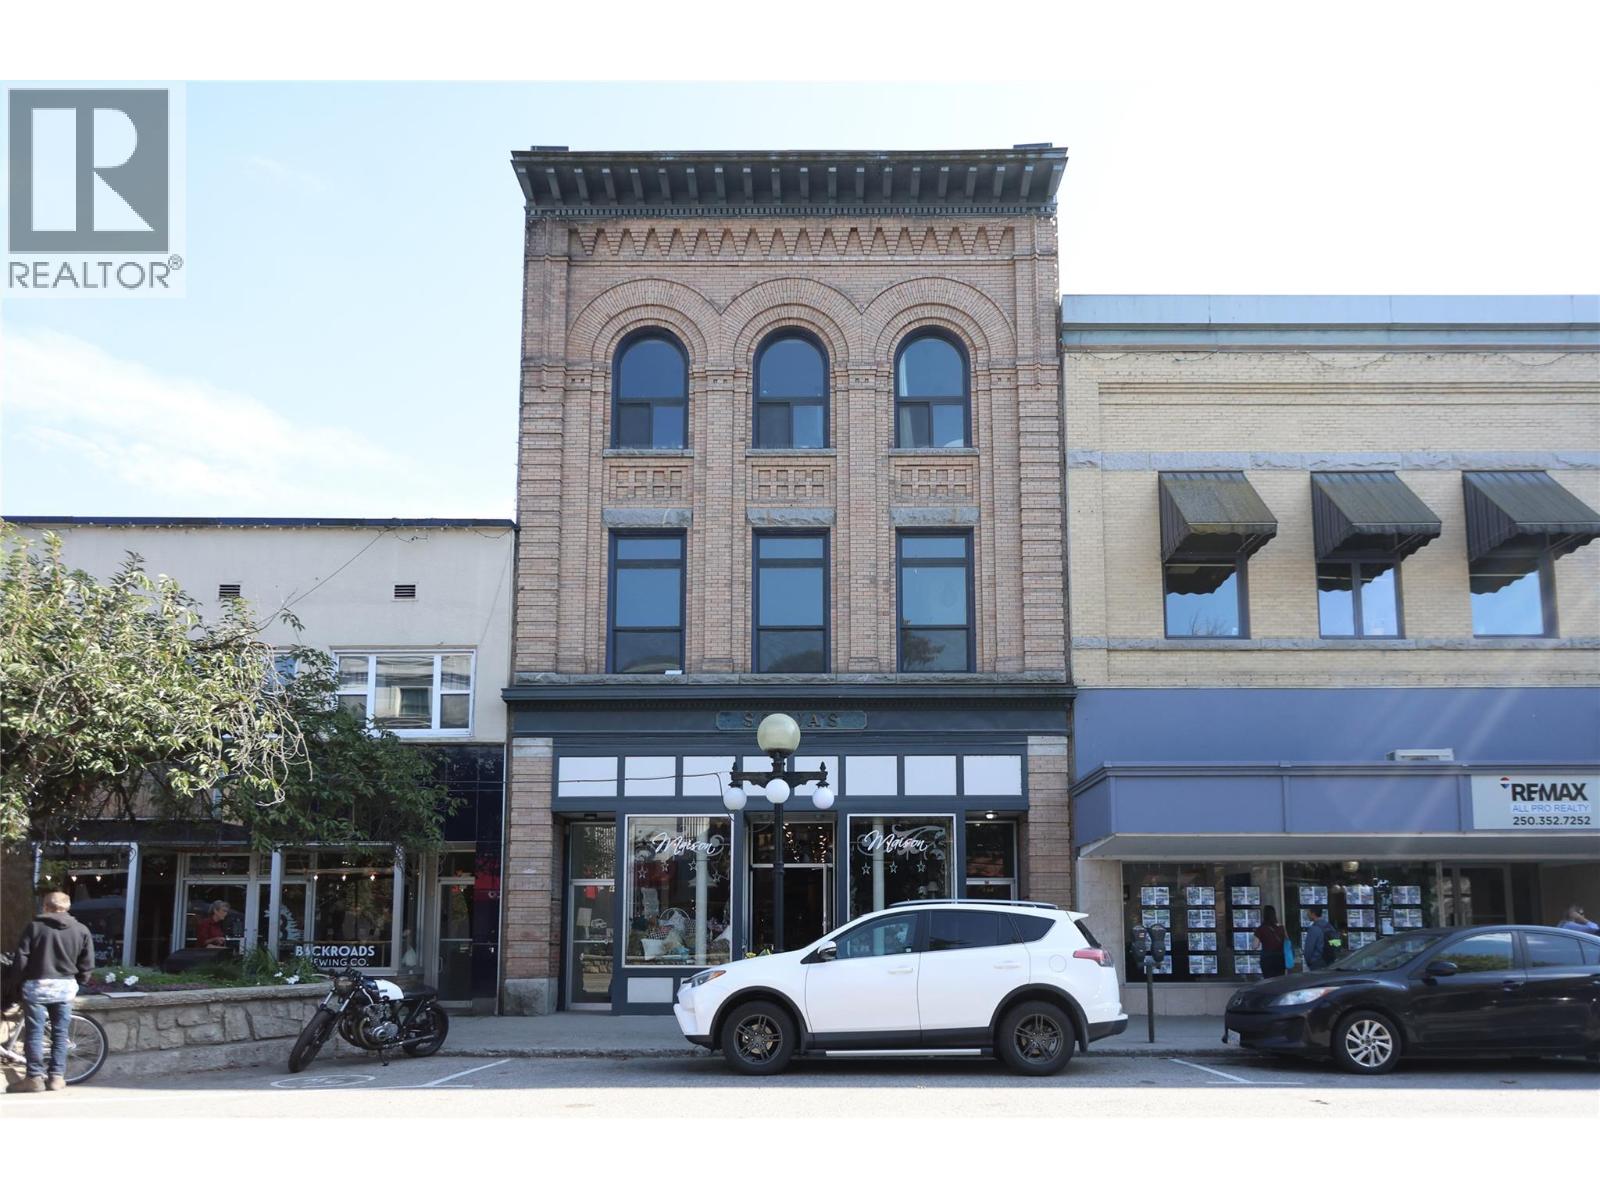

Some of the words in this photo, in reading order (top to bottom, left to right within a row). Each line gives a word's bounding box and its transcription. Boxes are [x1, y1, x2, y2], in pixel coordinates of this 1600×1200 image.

[743, 711, 839, 728] SAS
[1512, 804, 1529, 813] ALL
[1531, 804, 1552, 813] PRO
[1553, 804, 1590, 812] REALTY
[1512, 816, 1591, 826] 250.352.7252
[350, 958, 369, 967] CO.
